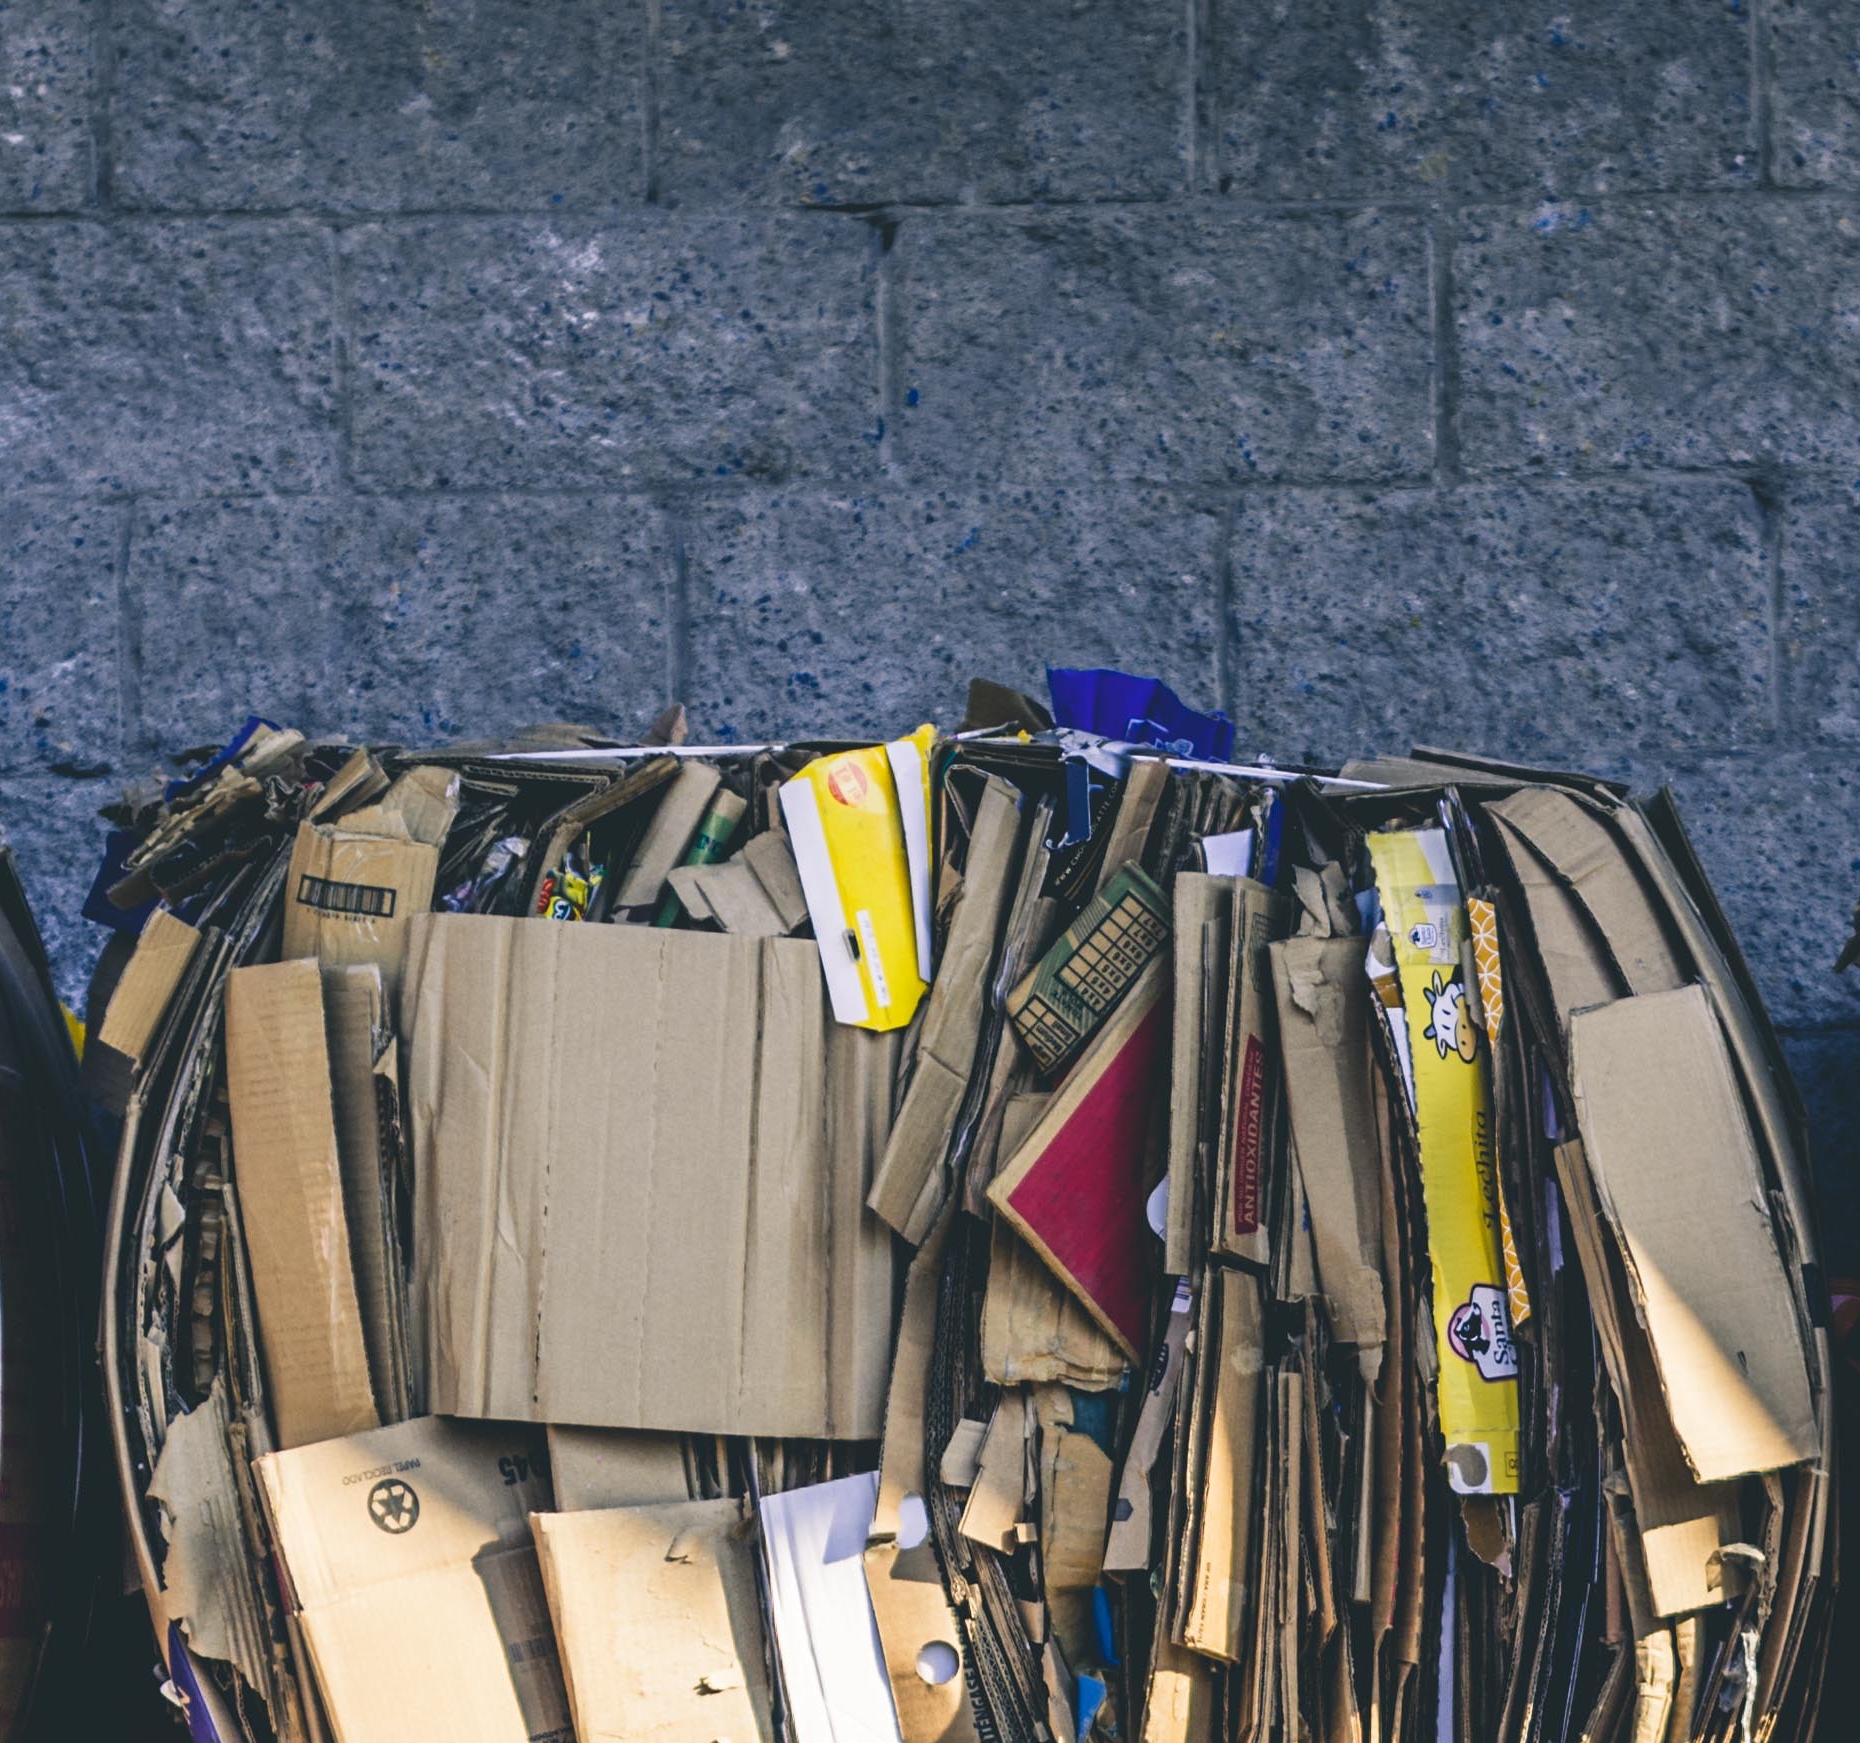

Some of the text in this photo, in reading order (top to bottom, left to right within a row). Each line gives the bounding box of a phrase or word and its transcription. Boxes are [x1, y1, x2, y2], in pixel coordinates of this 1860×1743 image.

[1244, 1051, 1263, 1225] ANTIOXIDANTES
[1476, 1108, 1495, 1232] Lechita
[1493, 1299, 1512, 1368] Santa
[342, 1457, 421, 1487] PAPEL RECICLADO
